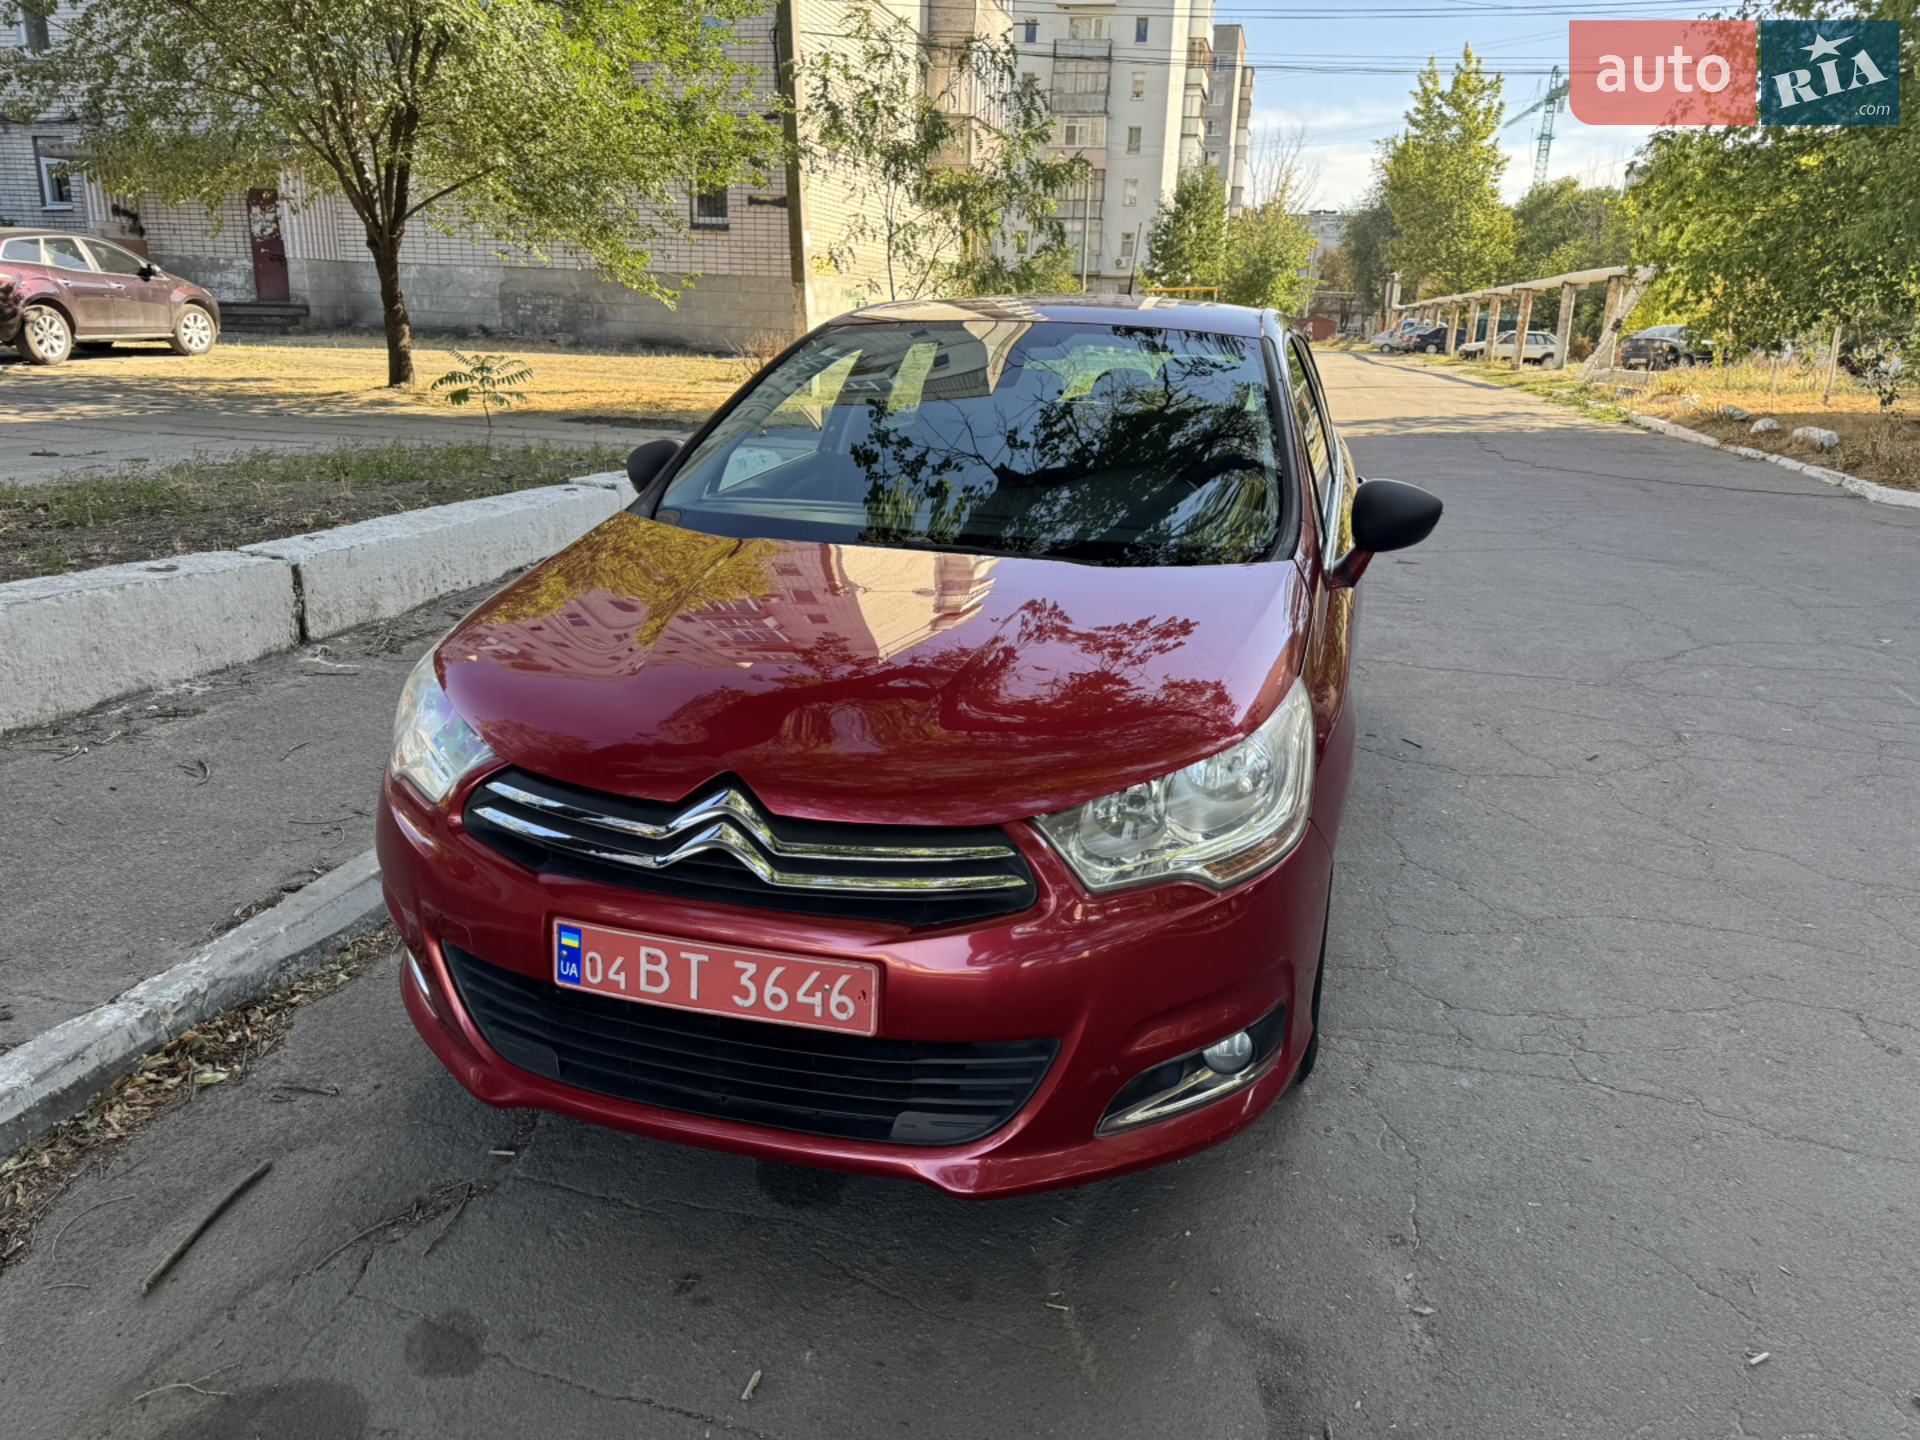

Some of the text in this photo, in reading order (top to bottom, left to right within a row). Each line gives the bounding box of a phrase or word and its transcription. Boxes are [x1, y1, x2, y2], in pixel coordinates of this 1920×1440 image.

[560, 960, 579, 978] UA
[585, 945, 856, 1021] 04 BT 3646
